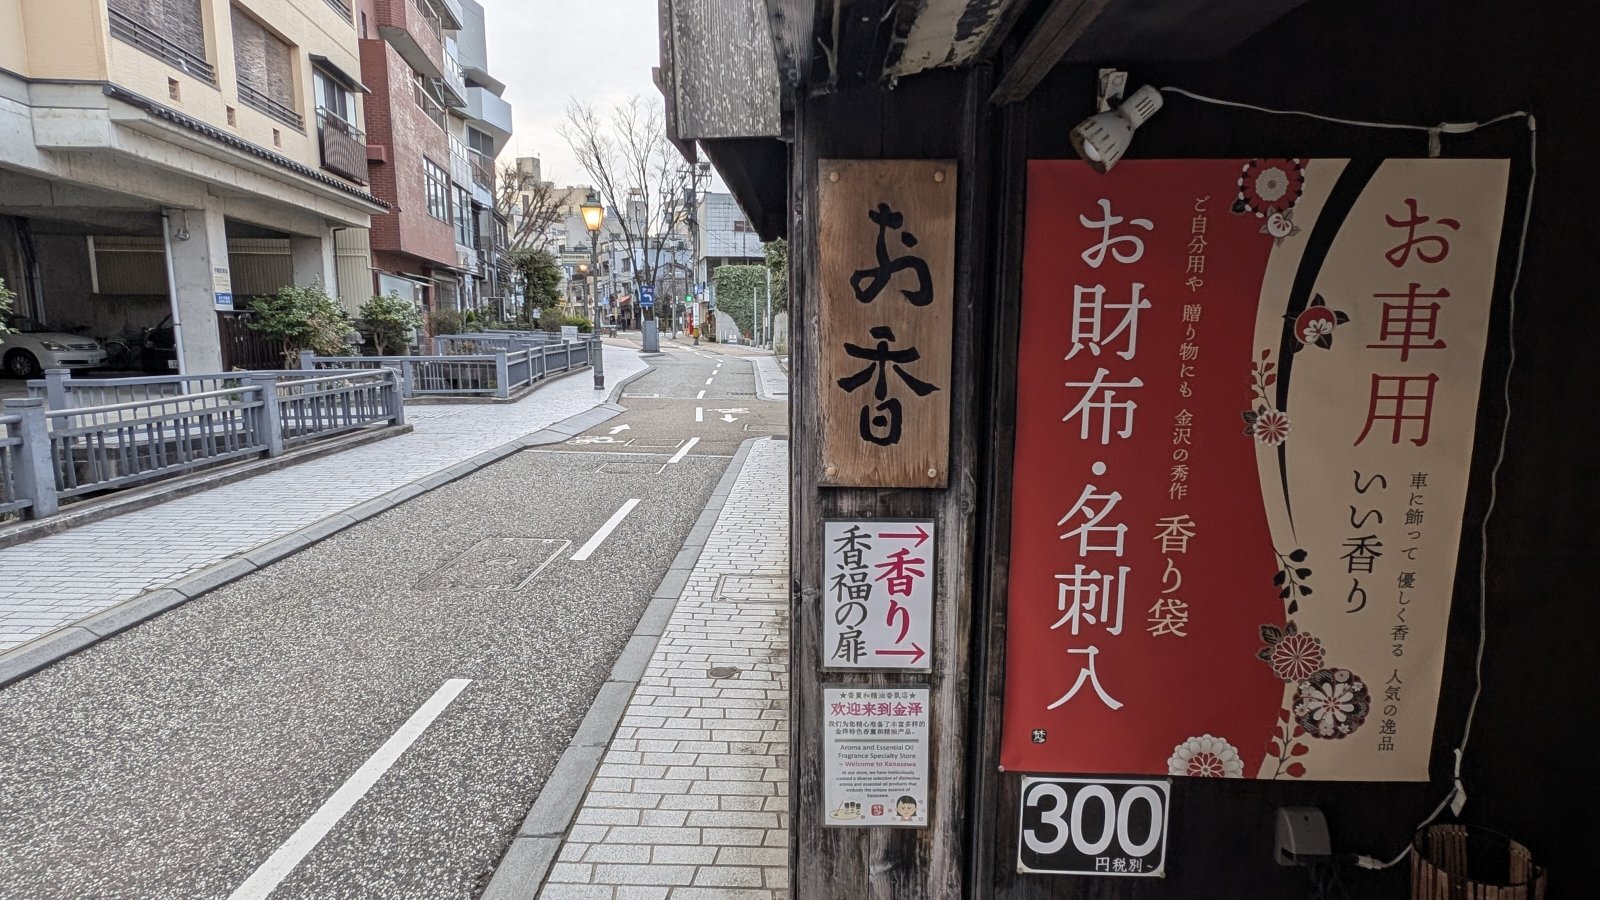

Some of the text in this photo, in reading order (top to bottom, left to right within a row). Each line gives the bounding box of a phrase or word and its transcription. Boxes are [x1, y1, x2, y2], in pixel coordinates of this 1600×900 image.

[837, 203, 941, 446] お香
[1147, 196, 1210, 638] ご自分用や 贈り物にも 金沢の秀作 香り袋
[1340, 198, 1460, 614] お車用 いい香り
[1047, 199, 1154, 710] お財布・名刺入
[830, 525, 872, 664] 香福の扉
[874, 548, 925, 644] 香り
[1377, 472, 1428, 752] 車に飾って 優しく香る 人気の逸品
[830, 702, 923, 717] 欢迎来到金泽
[838, 752, 869, 760] Fragrance
[870, 752, 898, 760] Specialty
[1023, 783, 1163, 857] 300
